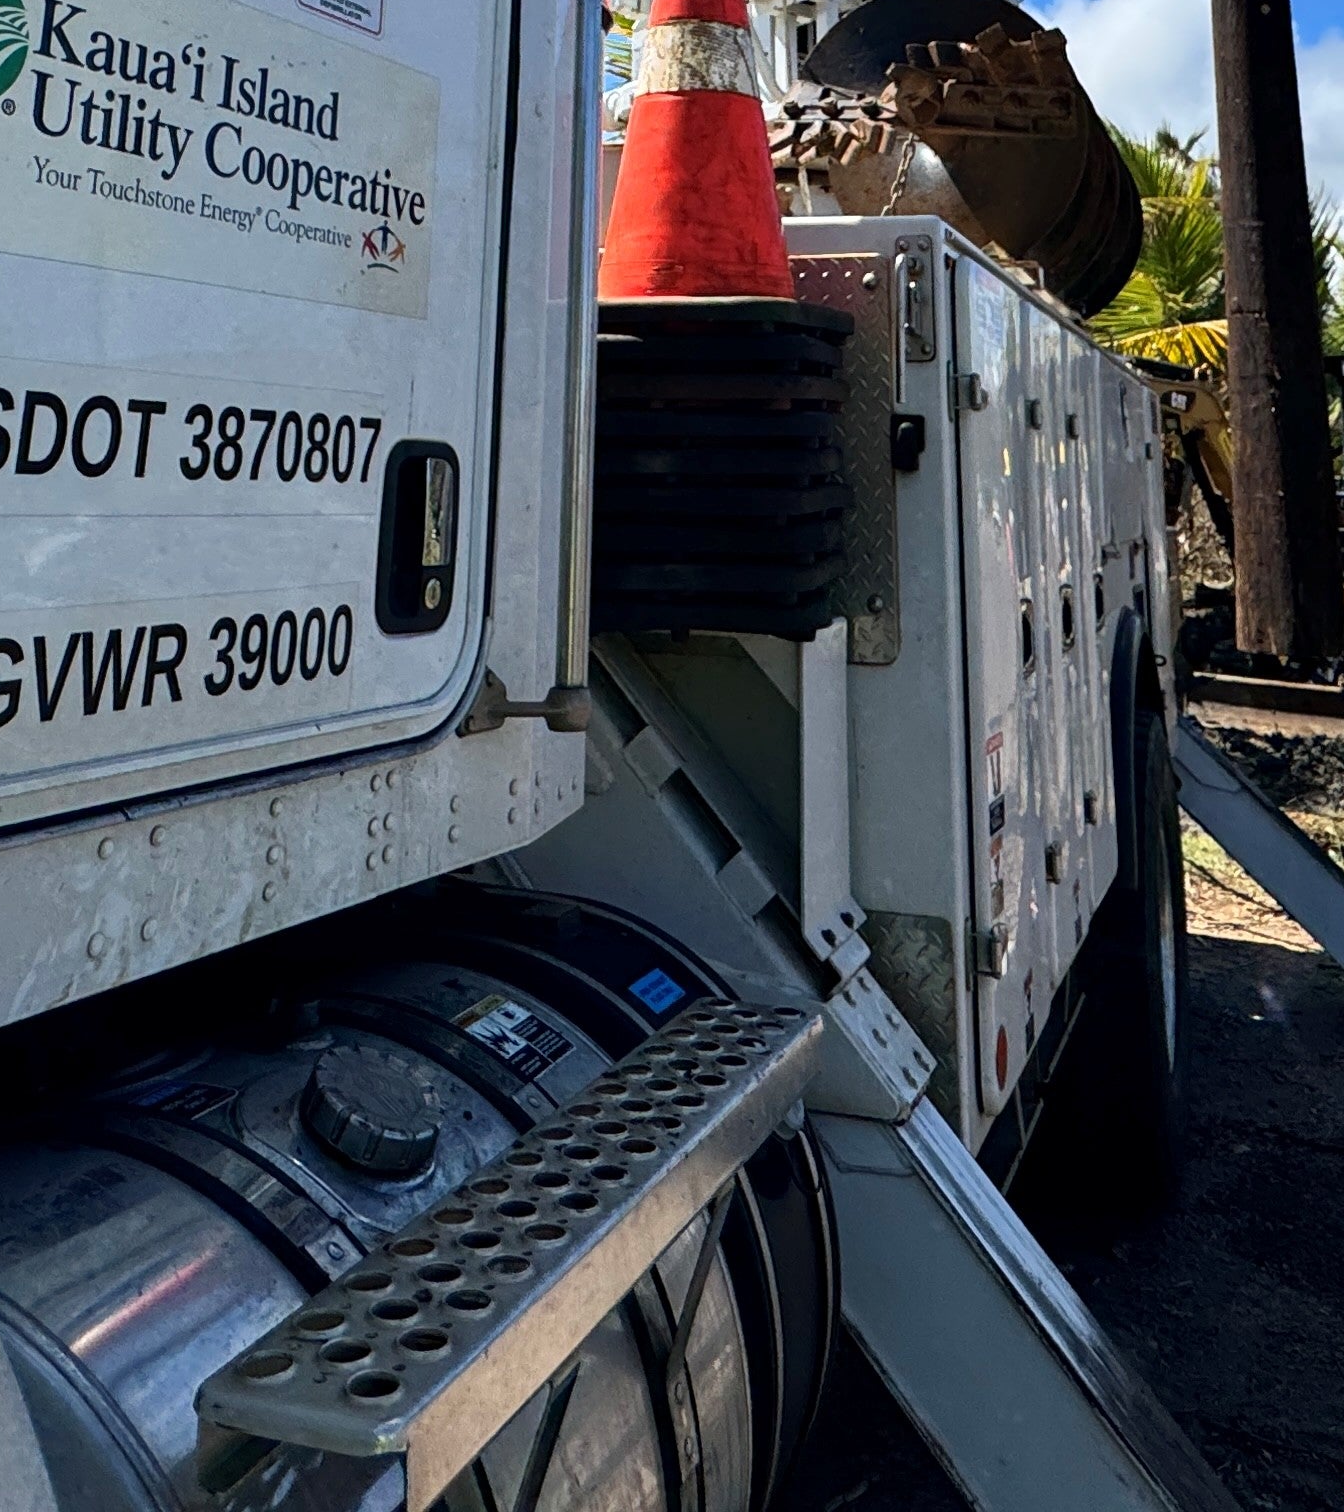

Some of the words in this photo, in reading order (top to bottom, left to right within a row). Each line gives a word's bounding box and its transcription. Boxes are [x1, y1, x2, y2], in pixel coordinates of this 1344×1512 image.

[221, 54, 339, 141] Island
[31, 69, 194, 181] Utility
[205, 121, 426, 226] Cooperative
[33, 155, 82, 191] Your
[86, 167, 195, 215] Touchstone
[265, 208, 352, 248] Cooperative
[178, 402, 383, 485] 3870807
[203, 603, 354, 699] 39000
